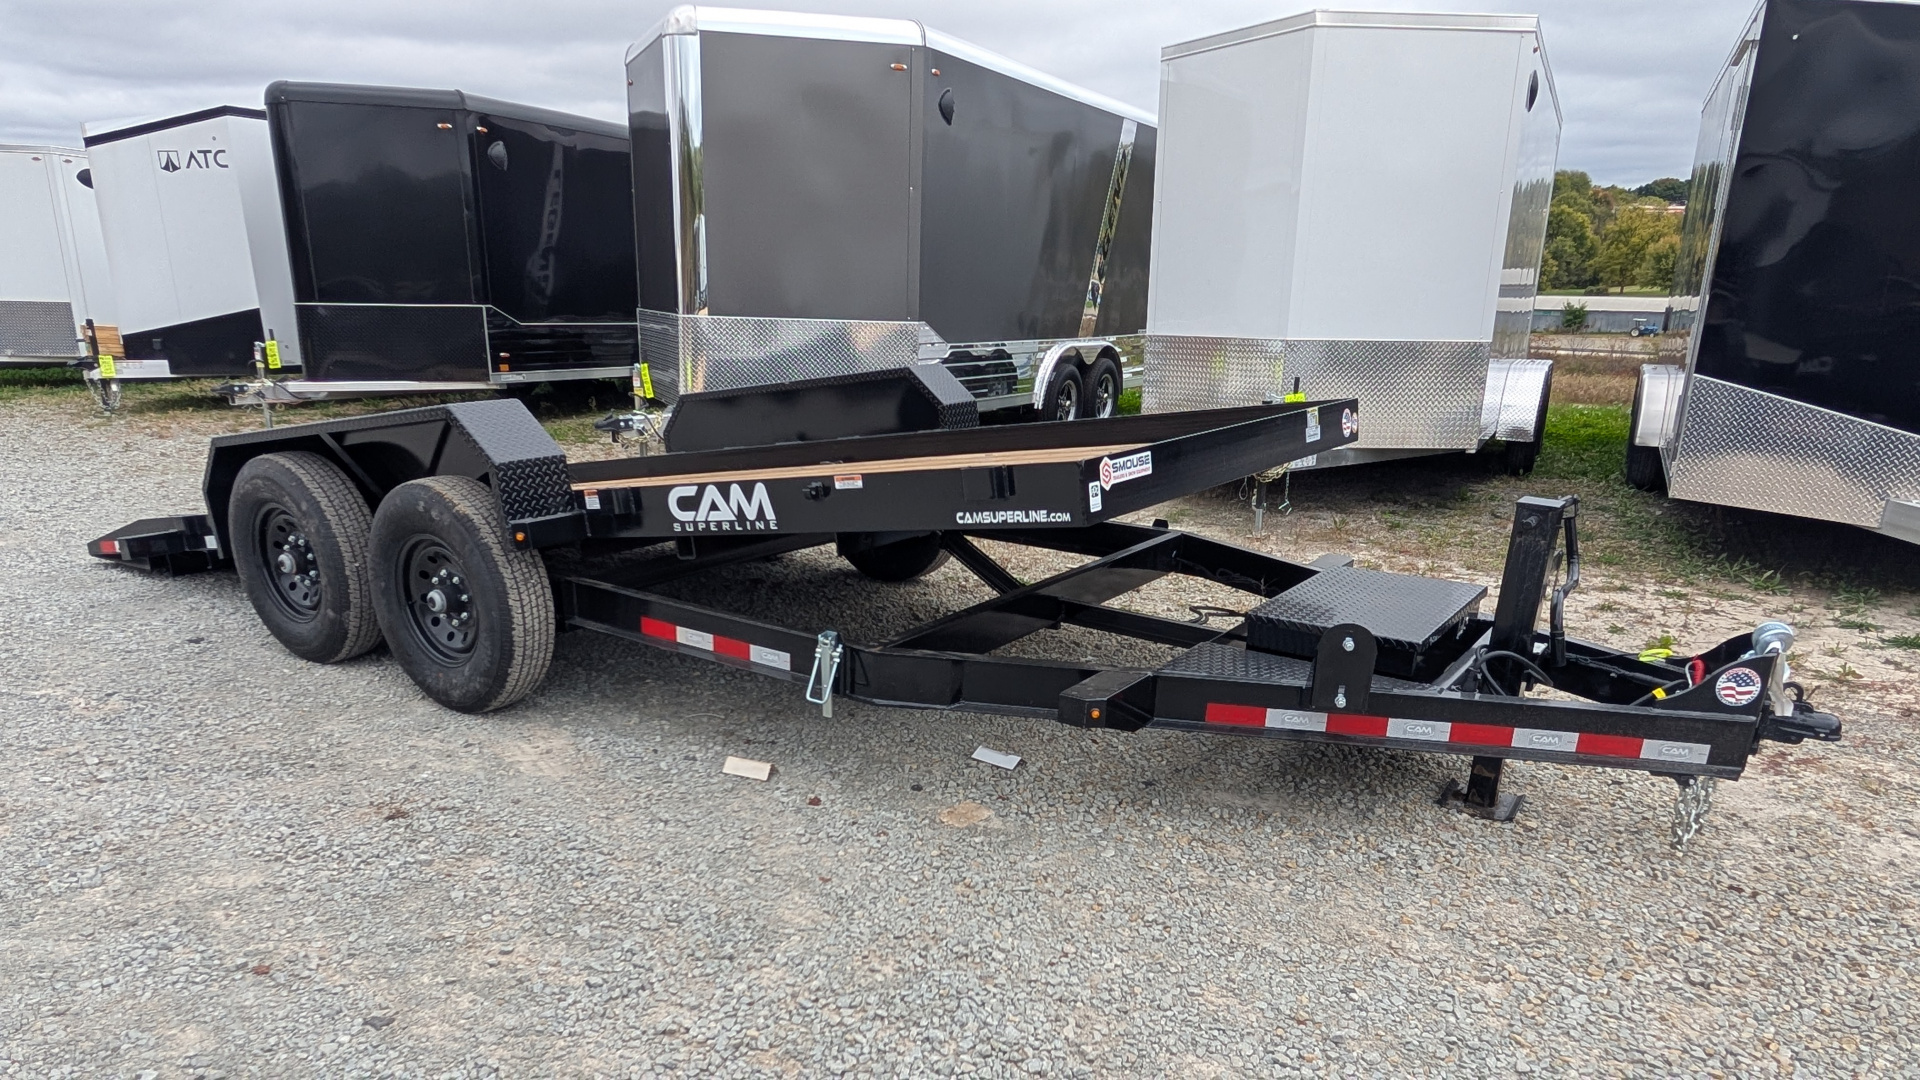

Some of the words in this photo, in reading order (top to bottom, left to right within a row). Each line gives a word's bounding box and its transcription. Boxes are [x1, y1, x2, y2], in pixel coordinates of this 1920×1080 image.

[186, 149, 229, 169] ATC
[1111, 454, 1151, 474] SMOUSE
[667, 481, 777, 522] CAM
[672, 520, 779, 532] SUPERLINE
[1283, 714, 1310, 724] CAM
[1405, 725, 1433, 735] CAM
[1531, 734, 1560, 745] CAM
[1661, 745, 1690, 756] CAM
